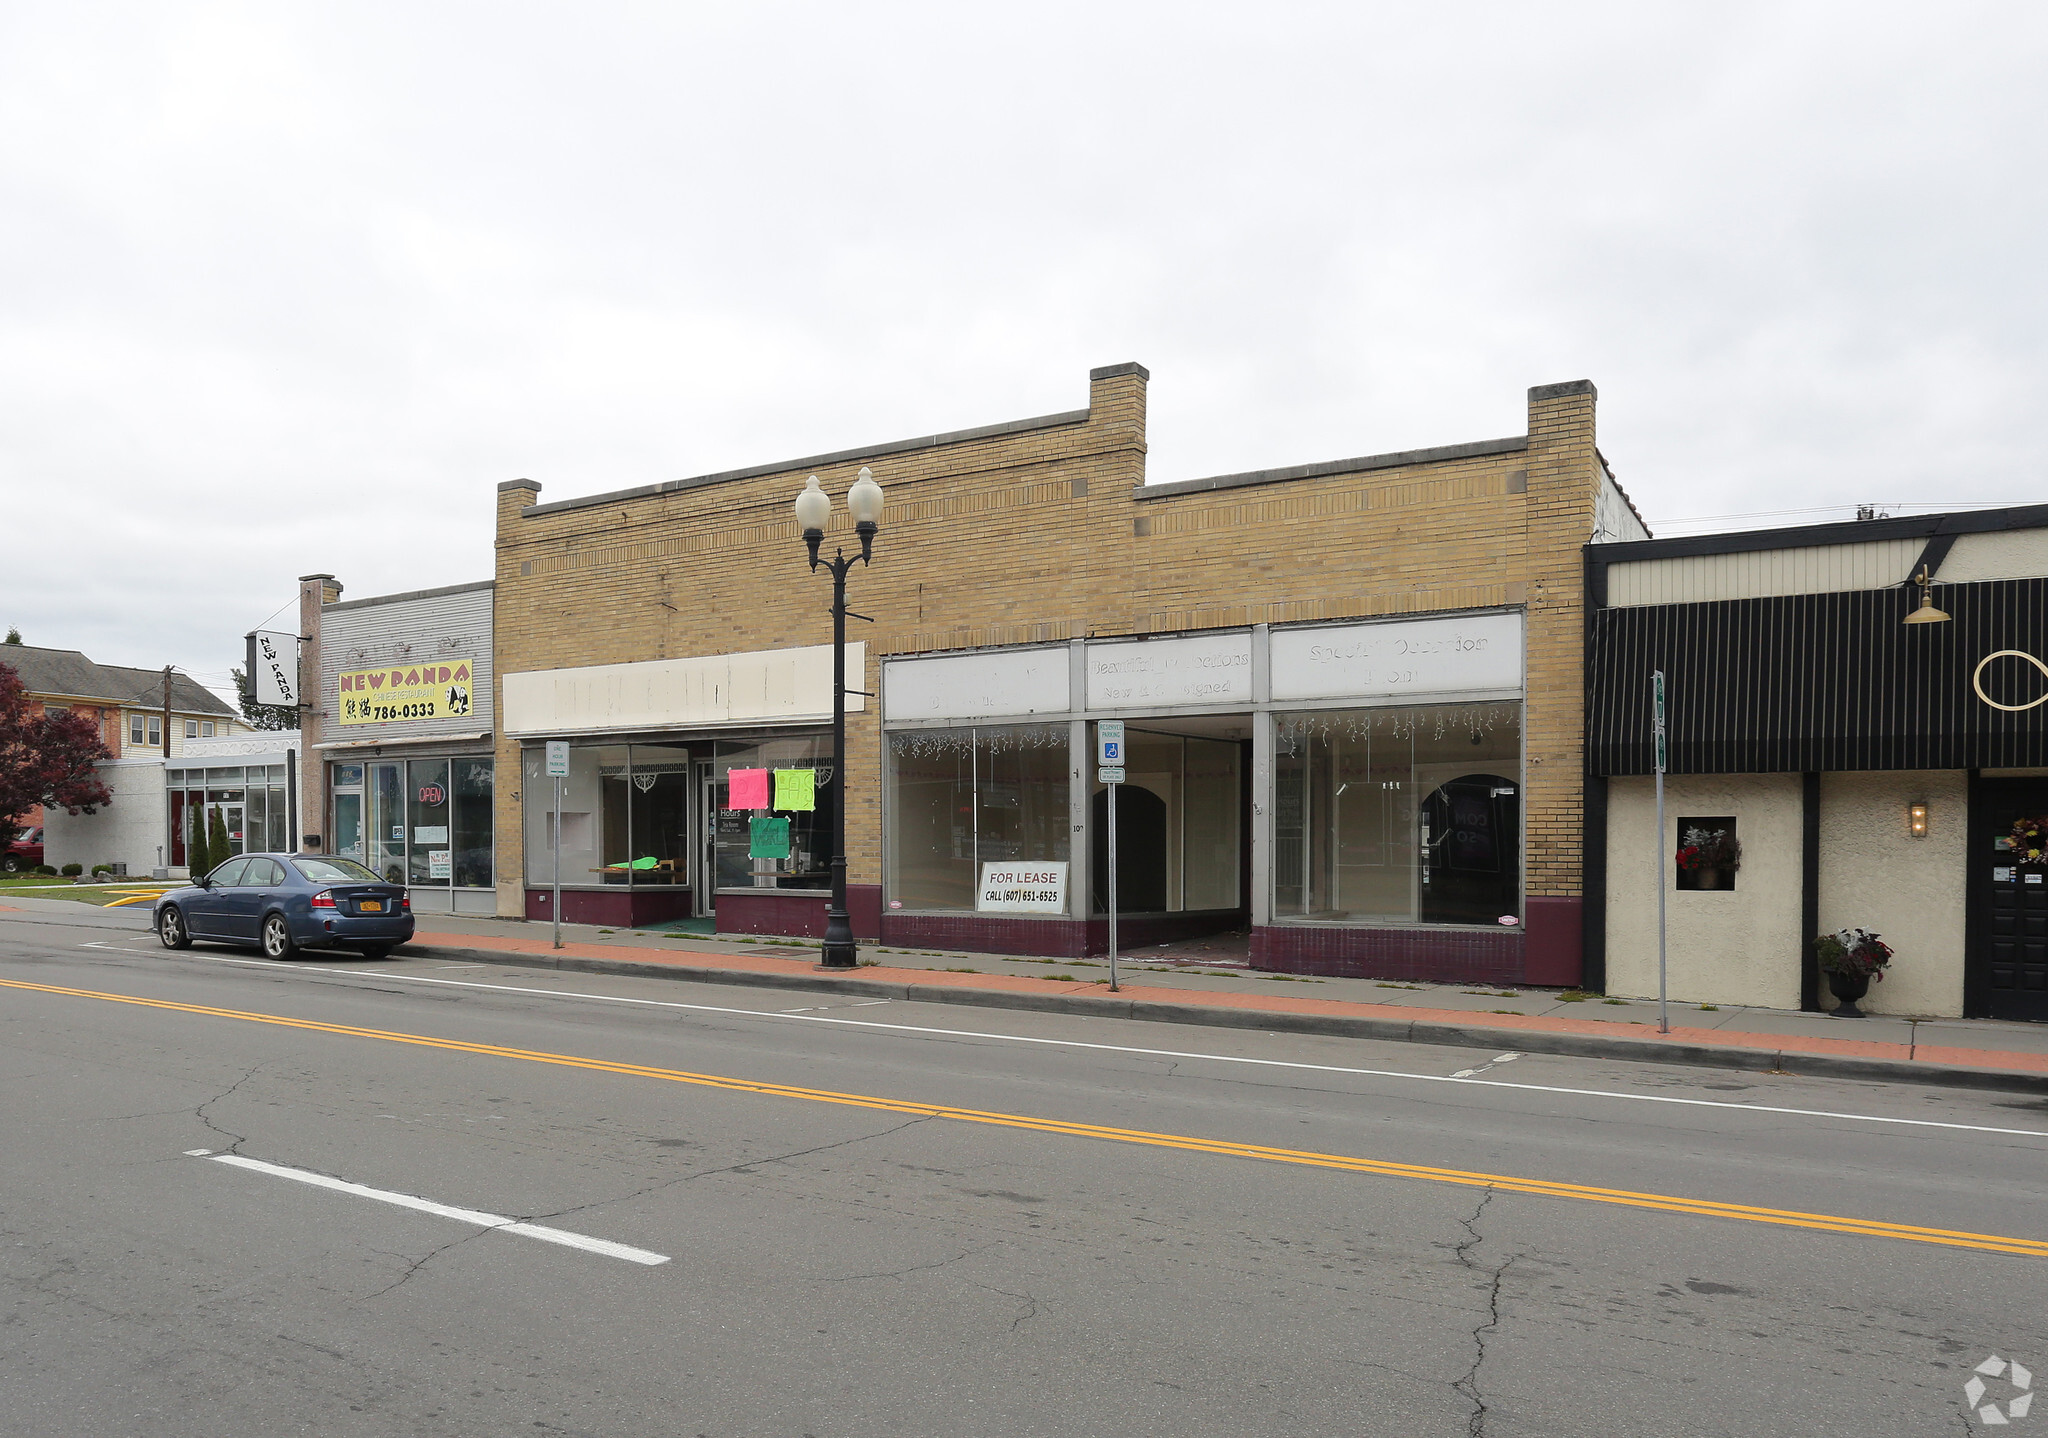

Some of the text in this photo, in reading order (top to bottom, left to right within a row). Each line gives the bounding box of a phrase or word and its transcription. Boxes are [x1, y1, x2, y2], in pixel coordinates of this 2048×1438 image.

[260, 637, 293, 700] NEW PANDA
[341, 663, 470, 693] NEW PANDA
[374, 702, 435, 720] 786-0333
[419, 787, 441, 802] OPEN
[720, 809, 741, 817] Hours
[990, 873, 1057, 884] FOR LEASE
[986, 889, 1058, 903] CALL (607) 651-6525
